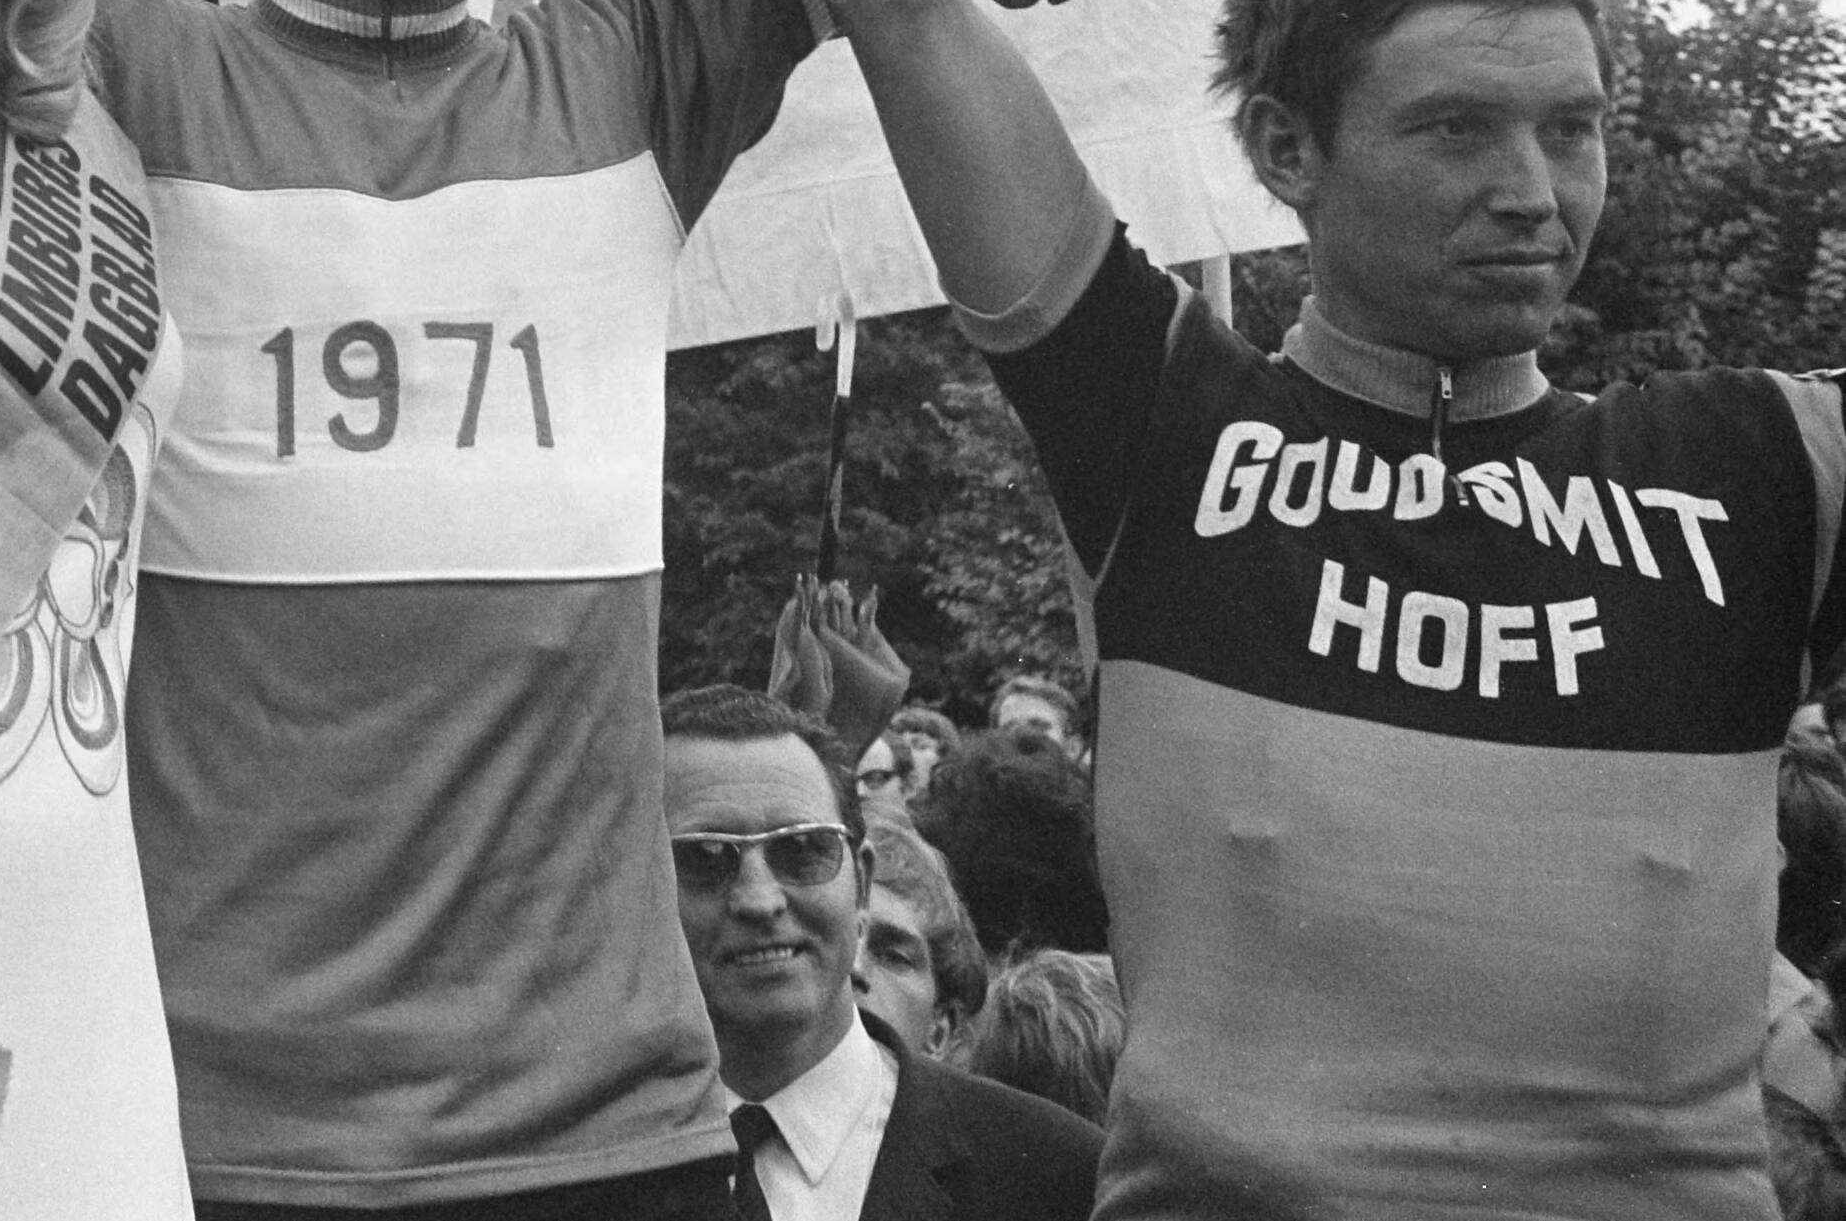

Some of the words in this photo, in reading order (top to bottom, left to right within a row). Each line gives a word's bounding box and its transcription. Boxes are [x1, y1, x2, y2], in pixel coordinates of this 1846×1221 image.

[58, 174, 162, 445] DAGBLAD
[260, 319, 555, 459] 1971
[1194, 420, 1729, 607] GOUDSMIT
[1308, 558, 1605, 699] HOFF
